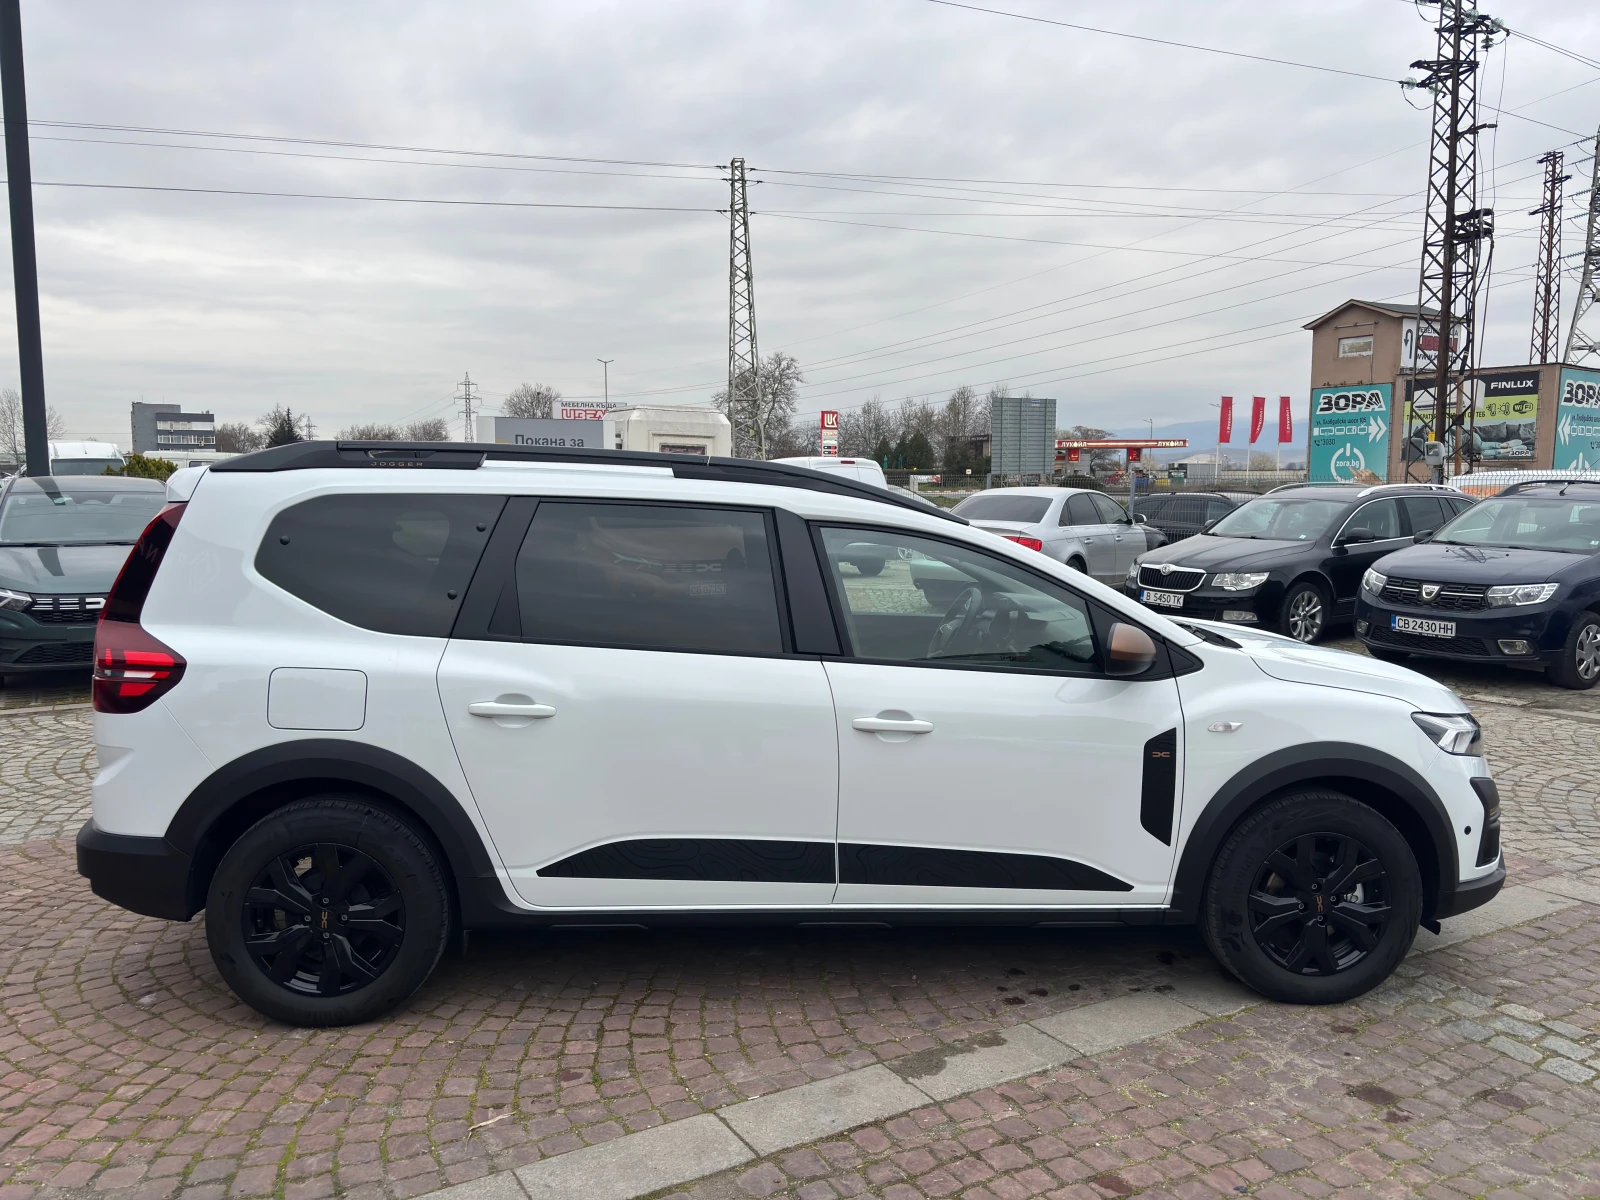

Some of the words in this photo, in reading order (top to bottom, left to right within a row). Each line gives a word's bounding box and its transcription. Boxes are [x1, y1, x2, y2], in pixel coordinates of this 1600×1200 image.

[1491, 380, 1534, 390] FINLUX
[1316, 390, 1386, 415] ЗОРА
[515, 434, 566, 447] Покана
[570, 438, 584, 447] за
[1336, 460, 1360, 468] zora.bg
[1146, 592, 1151, 601] B
[1154, 593, 1171, 603] 5450
[1173, 595, 1182, 605] TK
[1397, 618, 1410, 629] CB
[1412, 620, 1437, 633] 2430
[1439, 623, 1454, 635] HH
